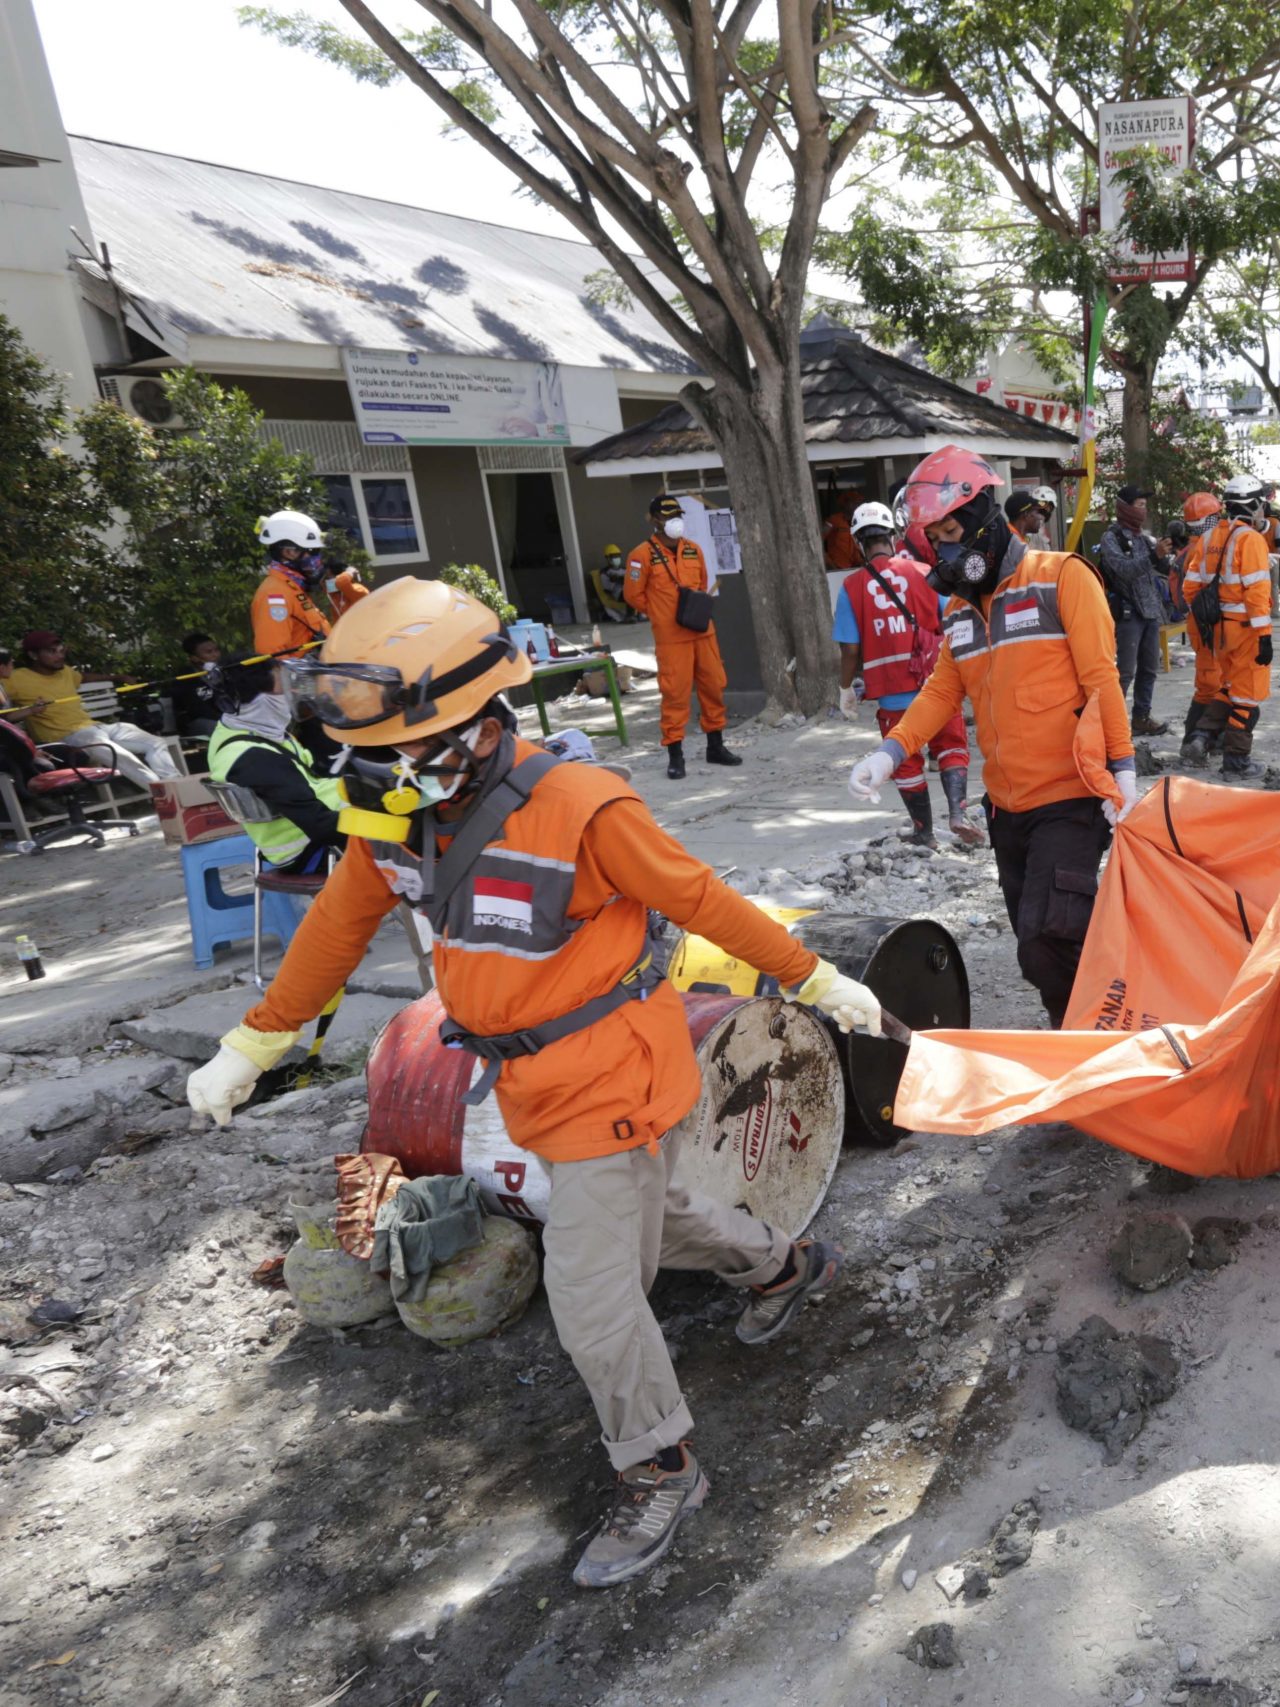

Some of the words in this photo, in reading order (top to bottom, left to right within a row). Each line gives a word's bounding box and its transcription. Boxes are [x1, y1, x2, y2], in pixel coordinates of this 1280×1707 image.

[1105, 116, 1184, 136] NASANAPURA
[1160, 263, 1185, 275] HOURS
[352, 365, 379, 375] Untuk
[381, 367, 429, 377] kemudahan
[430, 370, 444, 378] dan
[355, 379, 390, 388] rujukan
[391, 380, 408, 388] dari
[409, 381, 437, 390] Faskes
[457, 383, 467, 391] ke
[358, 390, 401, 399] dilakukan
[402, 392, 429, 401] secara
[1005, 619, 1041, 632] INDONESIA
[473, 914, 533, 936] INDONESA
[749, 1098, 768, 1159] EDITRAN
[747, 1161, 756, 1171] S
